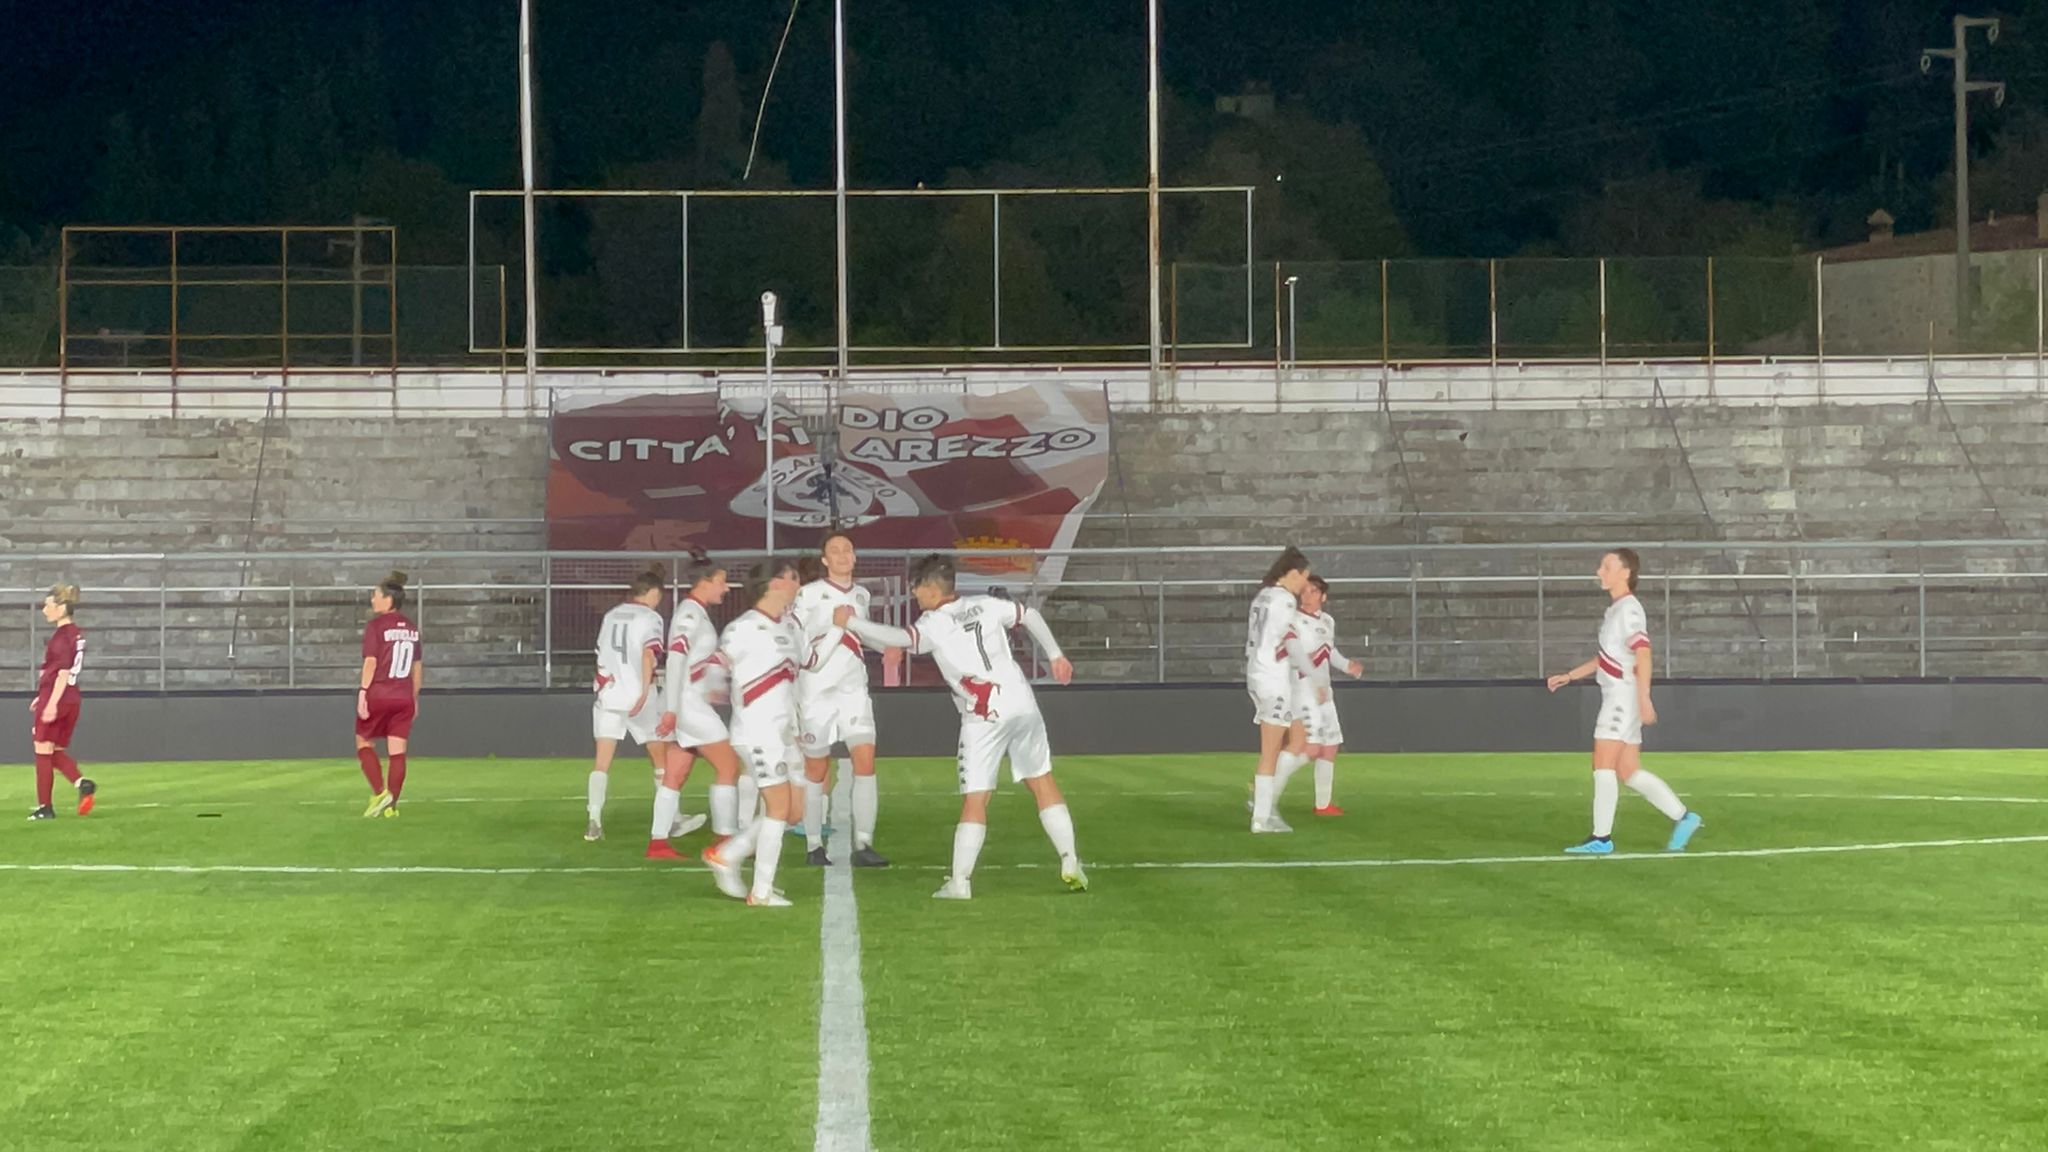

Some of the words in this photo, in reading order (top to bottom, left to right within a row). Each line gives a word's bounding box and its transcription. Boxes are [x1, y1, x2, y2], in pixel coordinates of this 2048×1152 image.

[850, 427, 1096, 462] AREZZO
[388, 640, 414, 679] 10
[611, 623, 629, 665] 4
[963, 620, 993, 672] 7
